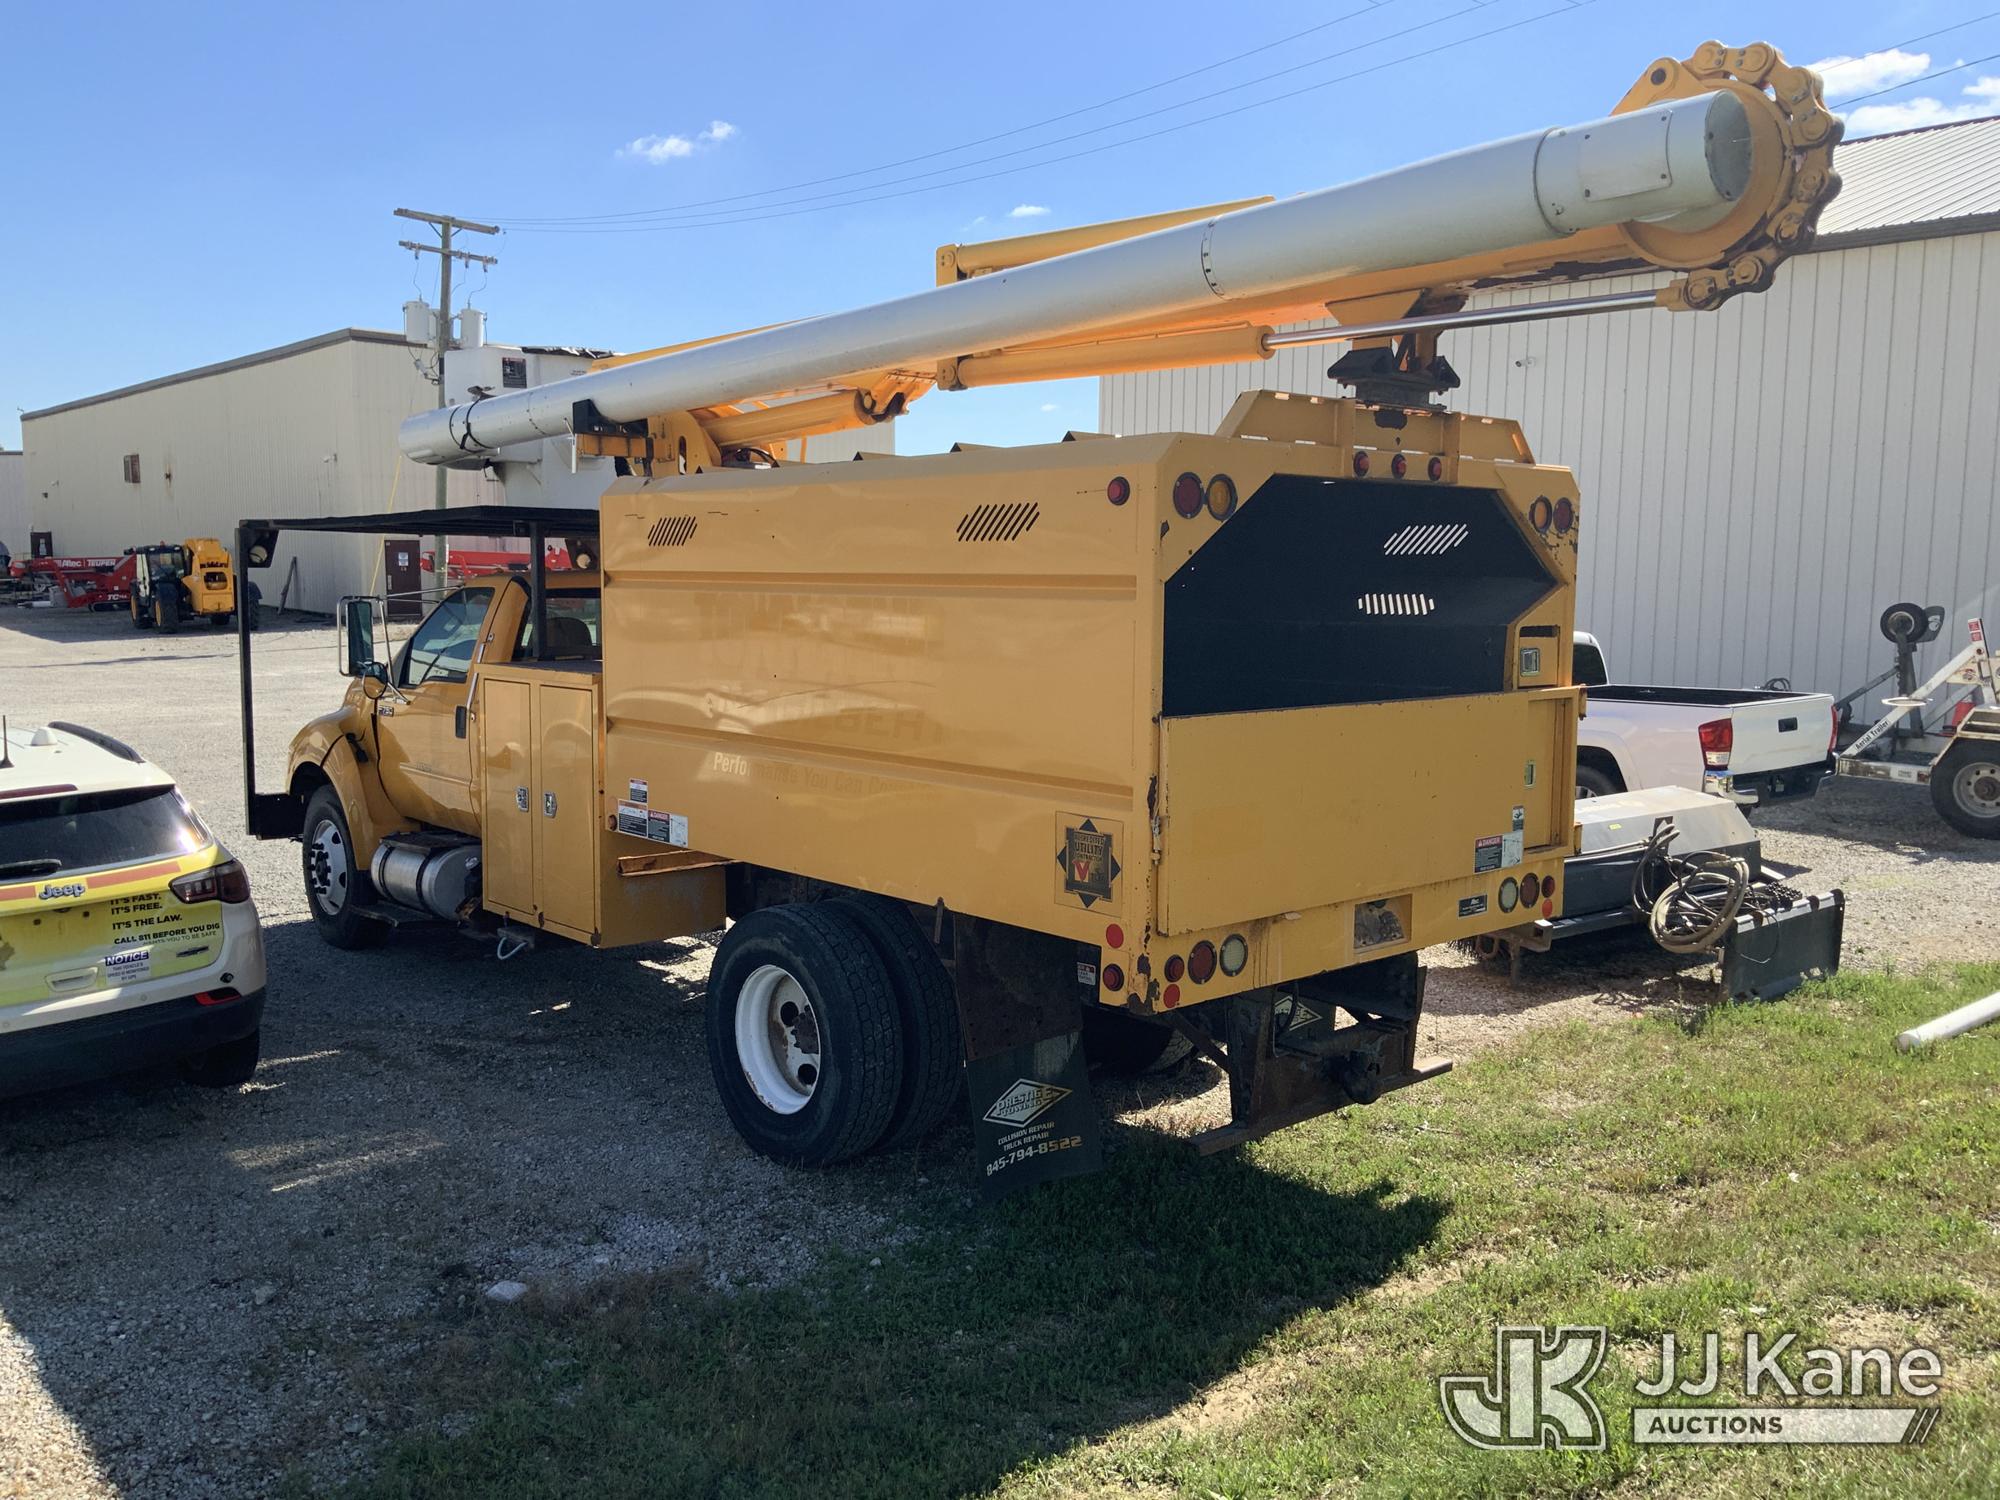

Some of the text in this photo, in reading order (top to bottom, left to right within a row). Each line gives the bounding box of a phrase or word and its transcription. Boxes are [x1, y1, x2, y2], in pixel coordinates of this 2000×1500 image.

[1870, 720, 1888, 737] Trailer
[803, 766, 829, 791] You
[1074, 841, 1104, 856] UTILITY
[39, 884, 86, 900] Jeep
[111, 902, 163, 915] IT'S FREE.
[112, 914, 182, 930] IT'S THE LAW.
[114, 922, 220, 945] CALL 811 BEFORE YOU DIG
[107, 951, 147, 965] NOTICE
[997, 1087, 1053, 1113] PRESTIGE
[998, 1121, 1055, 1146] COLLISION REPAIR
[1003, 1131, 1049, 1152] TRUCK REPAIR
[986, 1135, 1083, 1176] 845-794-8522
